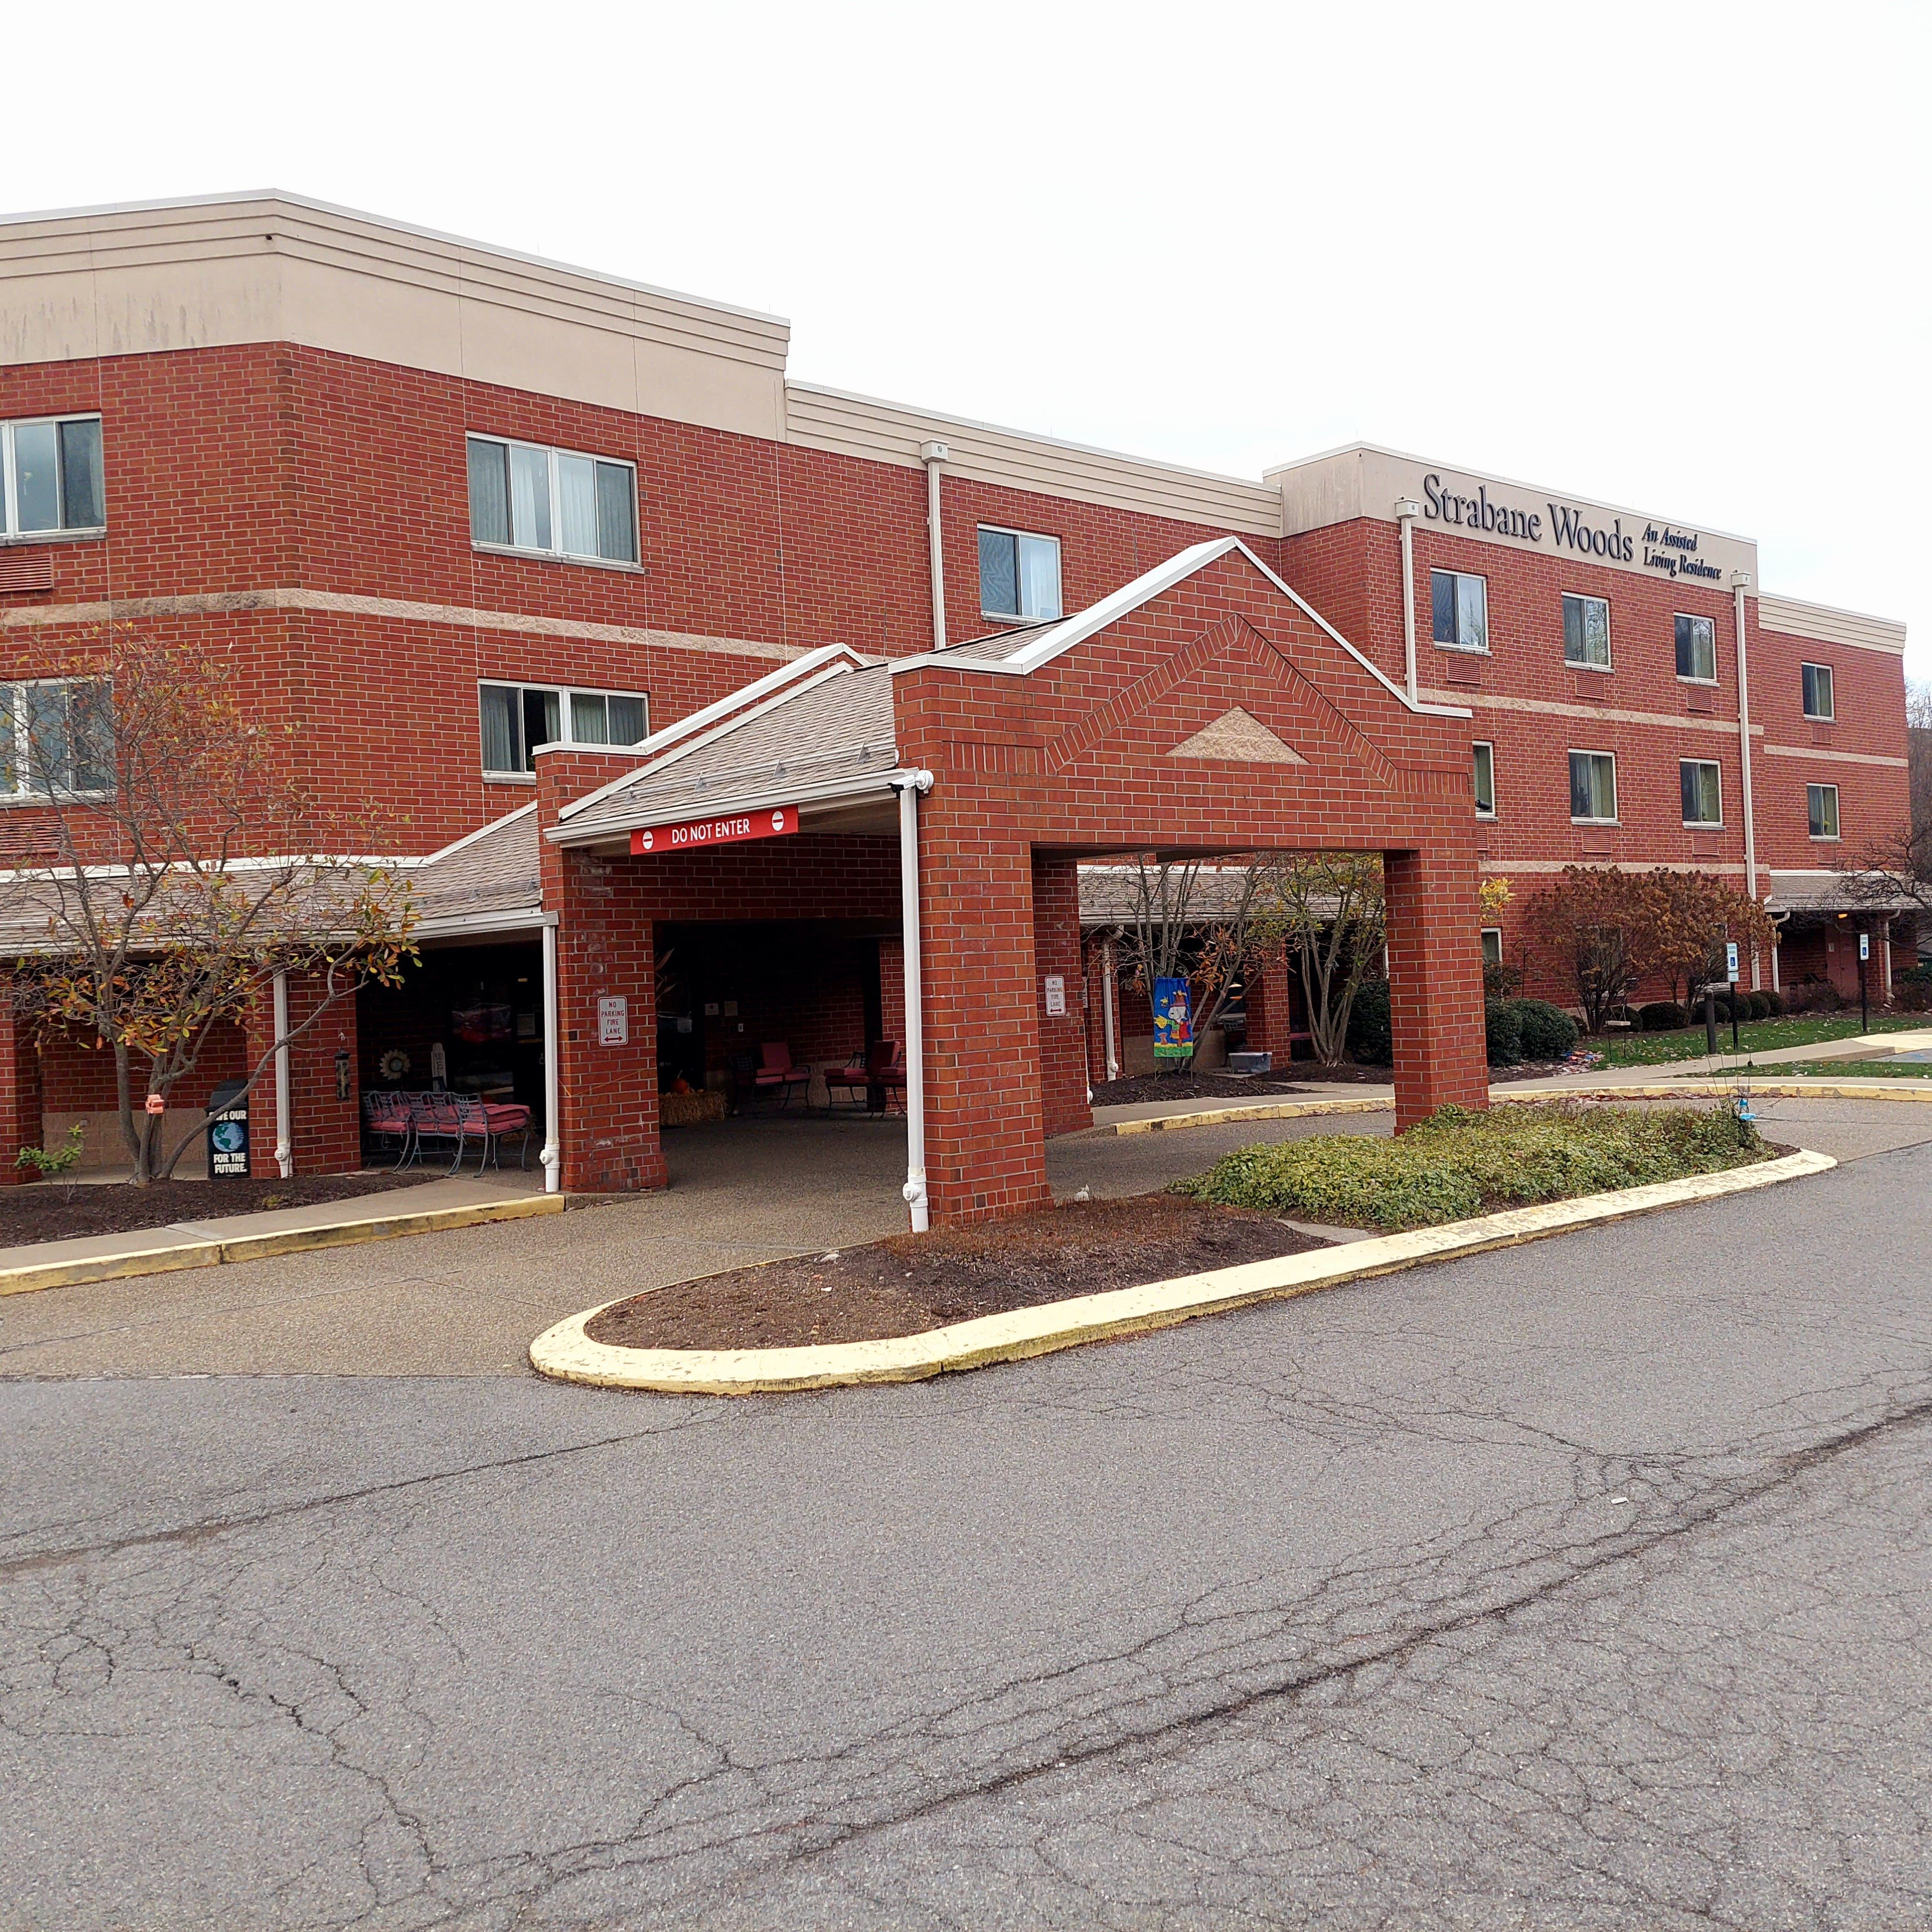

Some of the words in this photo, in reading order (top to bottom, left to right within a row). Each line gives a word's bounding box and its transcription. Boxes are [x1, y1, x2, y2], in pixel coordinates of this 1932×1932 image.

[1423, 473, 1542, 541] Strabane
[1547, 503, 1633, 561] Woods
[1641, 522, 1659, 543] An
[1660, 527, 1698, 551] Assisted
[1644, 546, 1677, 577] Living
[1679, 554, 1722, 580] Residence
[672, 827, 688, 844] DO
[690, 824, 713, 841] NOT
[716, 818, 751, 837] ENTER
[229, 1110, 247, 1120] OUR
[214, 1153, 229, 1163] FOR
[230, 1152, 246, 1162] THE
[214, 1163, 247, 1174] FUTURE.
